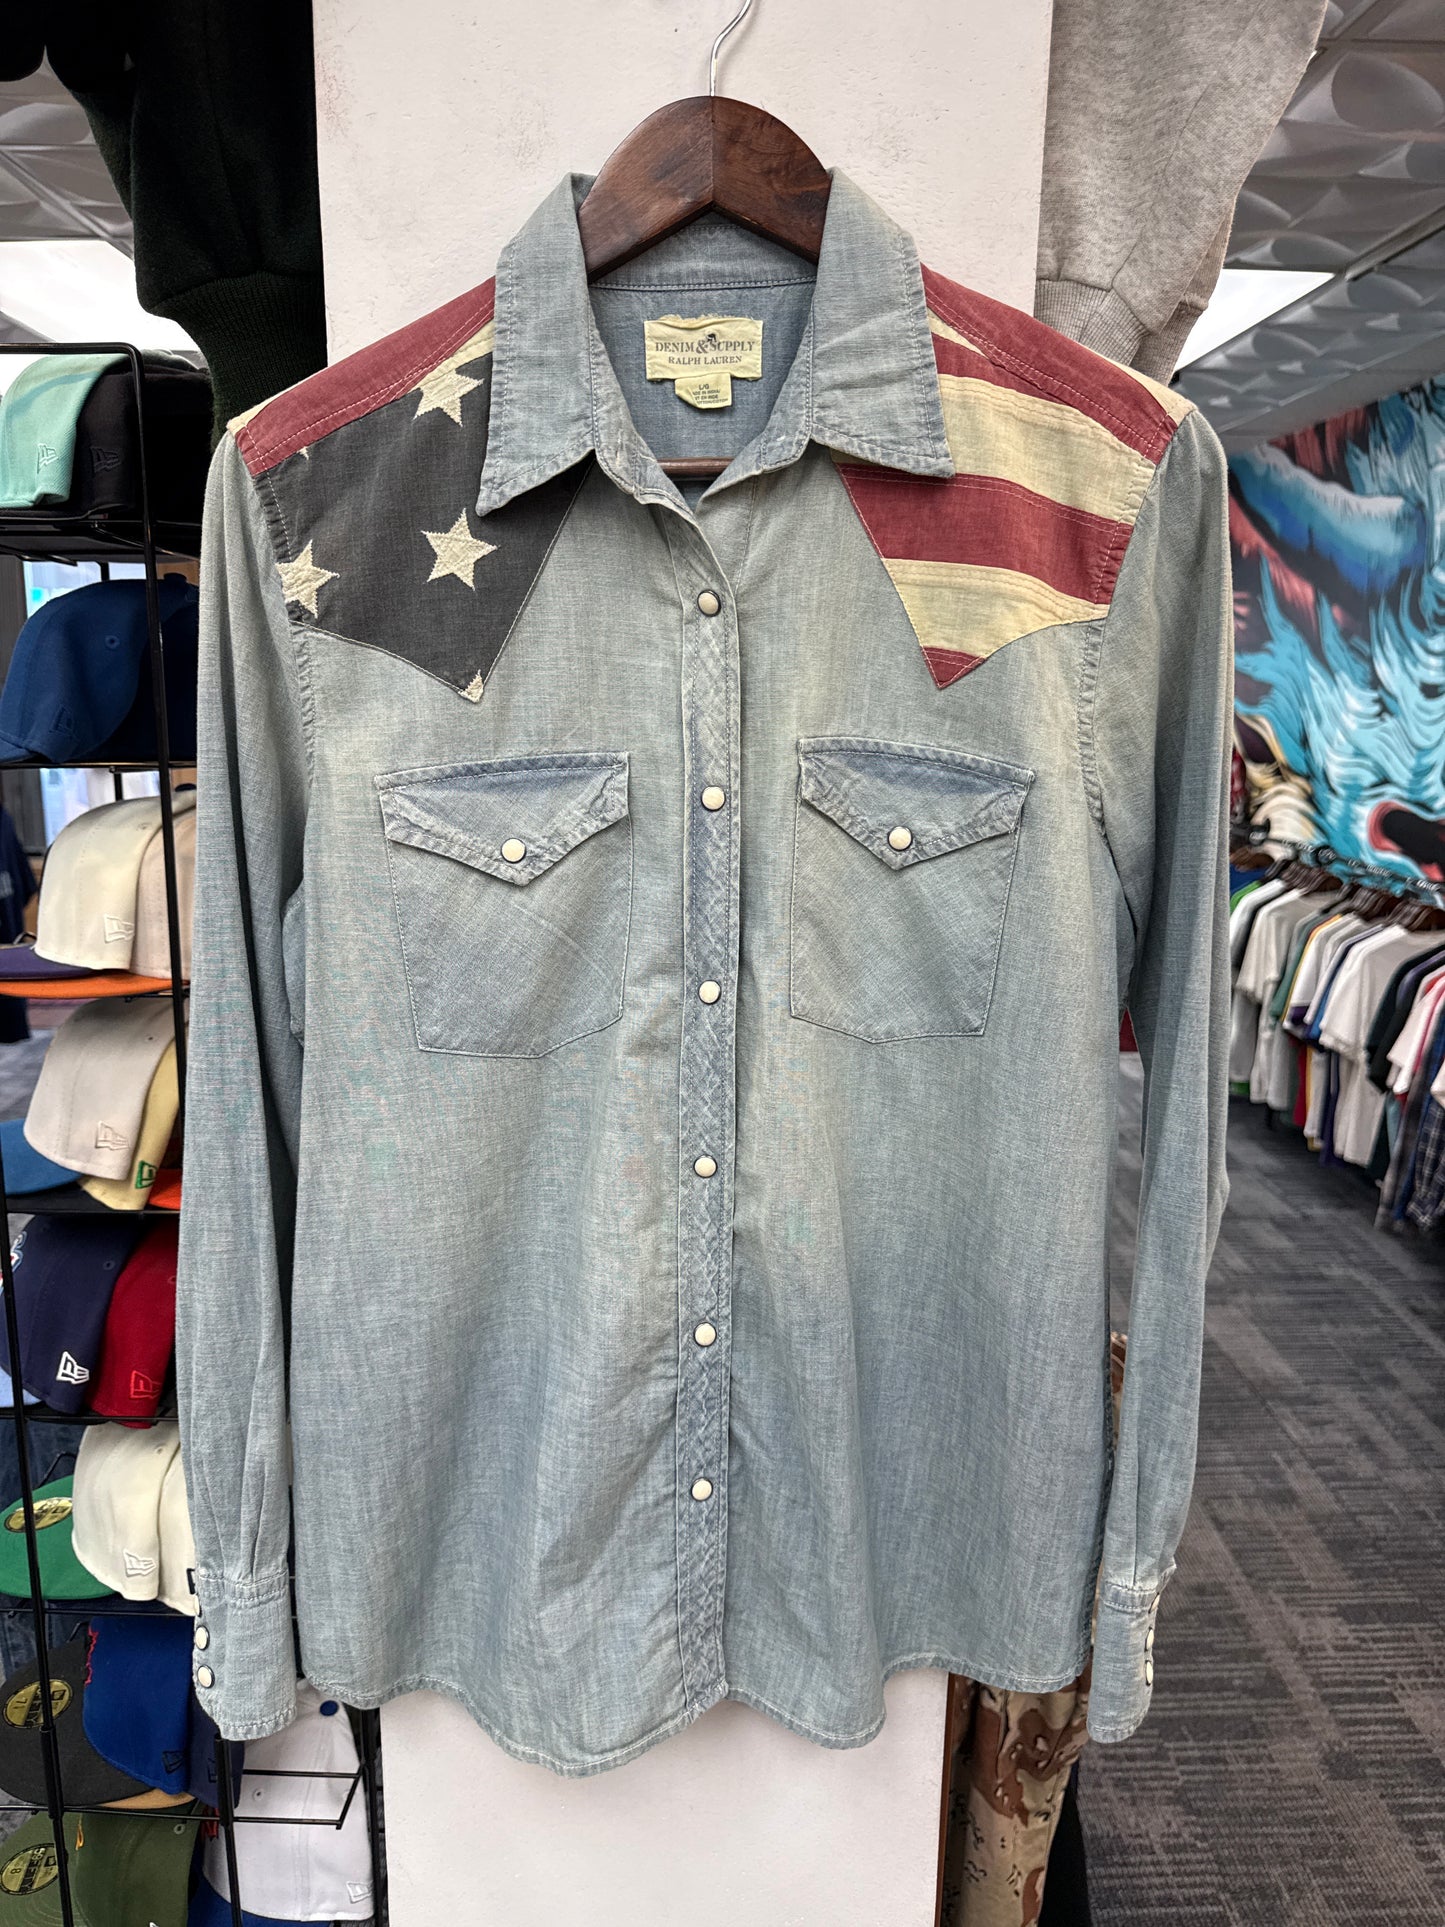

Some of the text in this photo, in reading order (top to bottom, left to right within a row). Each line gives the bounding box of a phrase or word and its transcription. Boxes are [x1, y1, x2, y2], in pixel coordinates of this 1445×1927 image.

[655, 341, 694, 352] DENIM
[711, 341, 755, 352] SUPPLY
[668, 355, 742, 365] RALPH LAUREN
